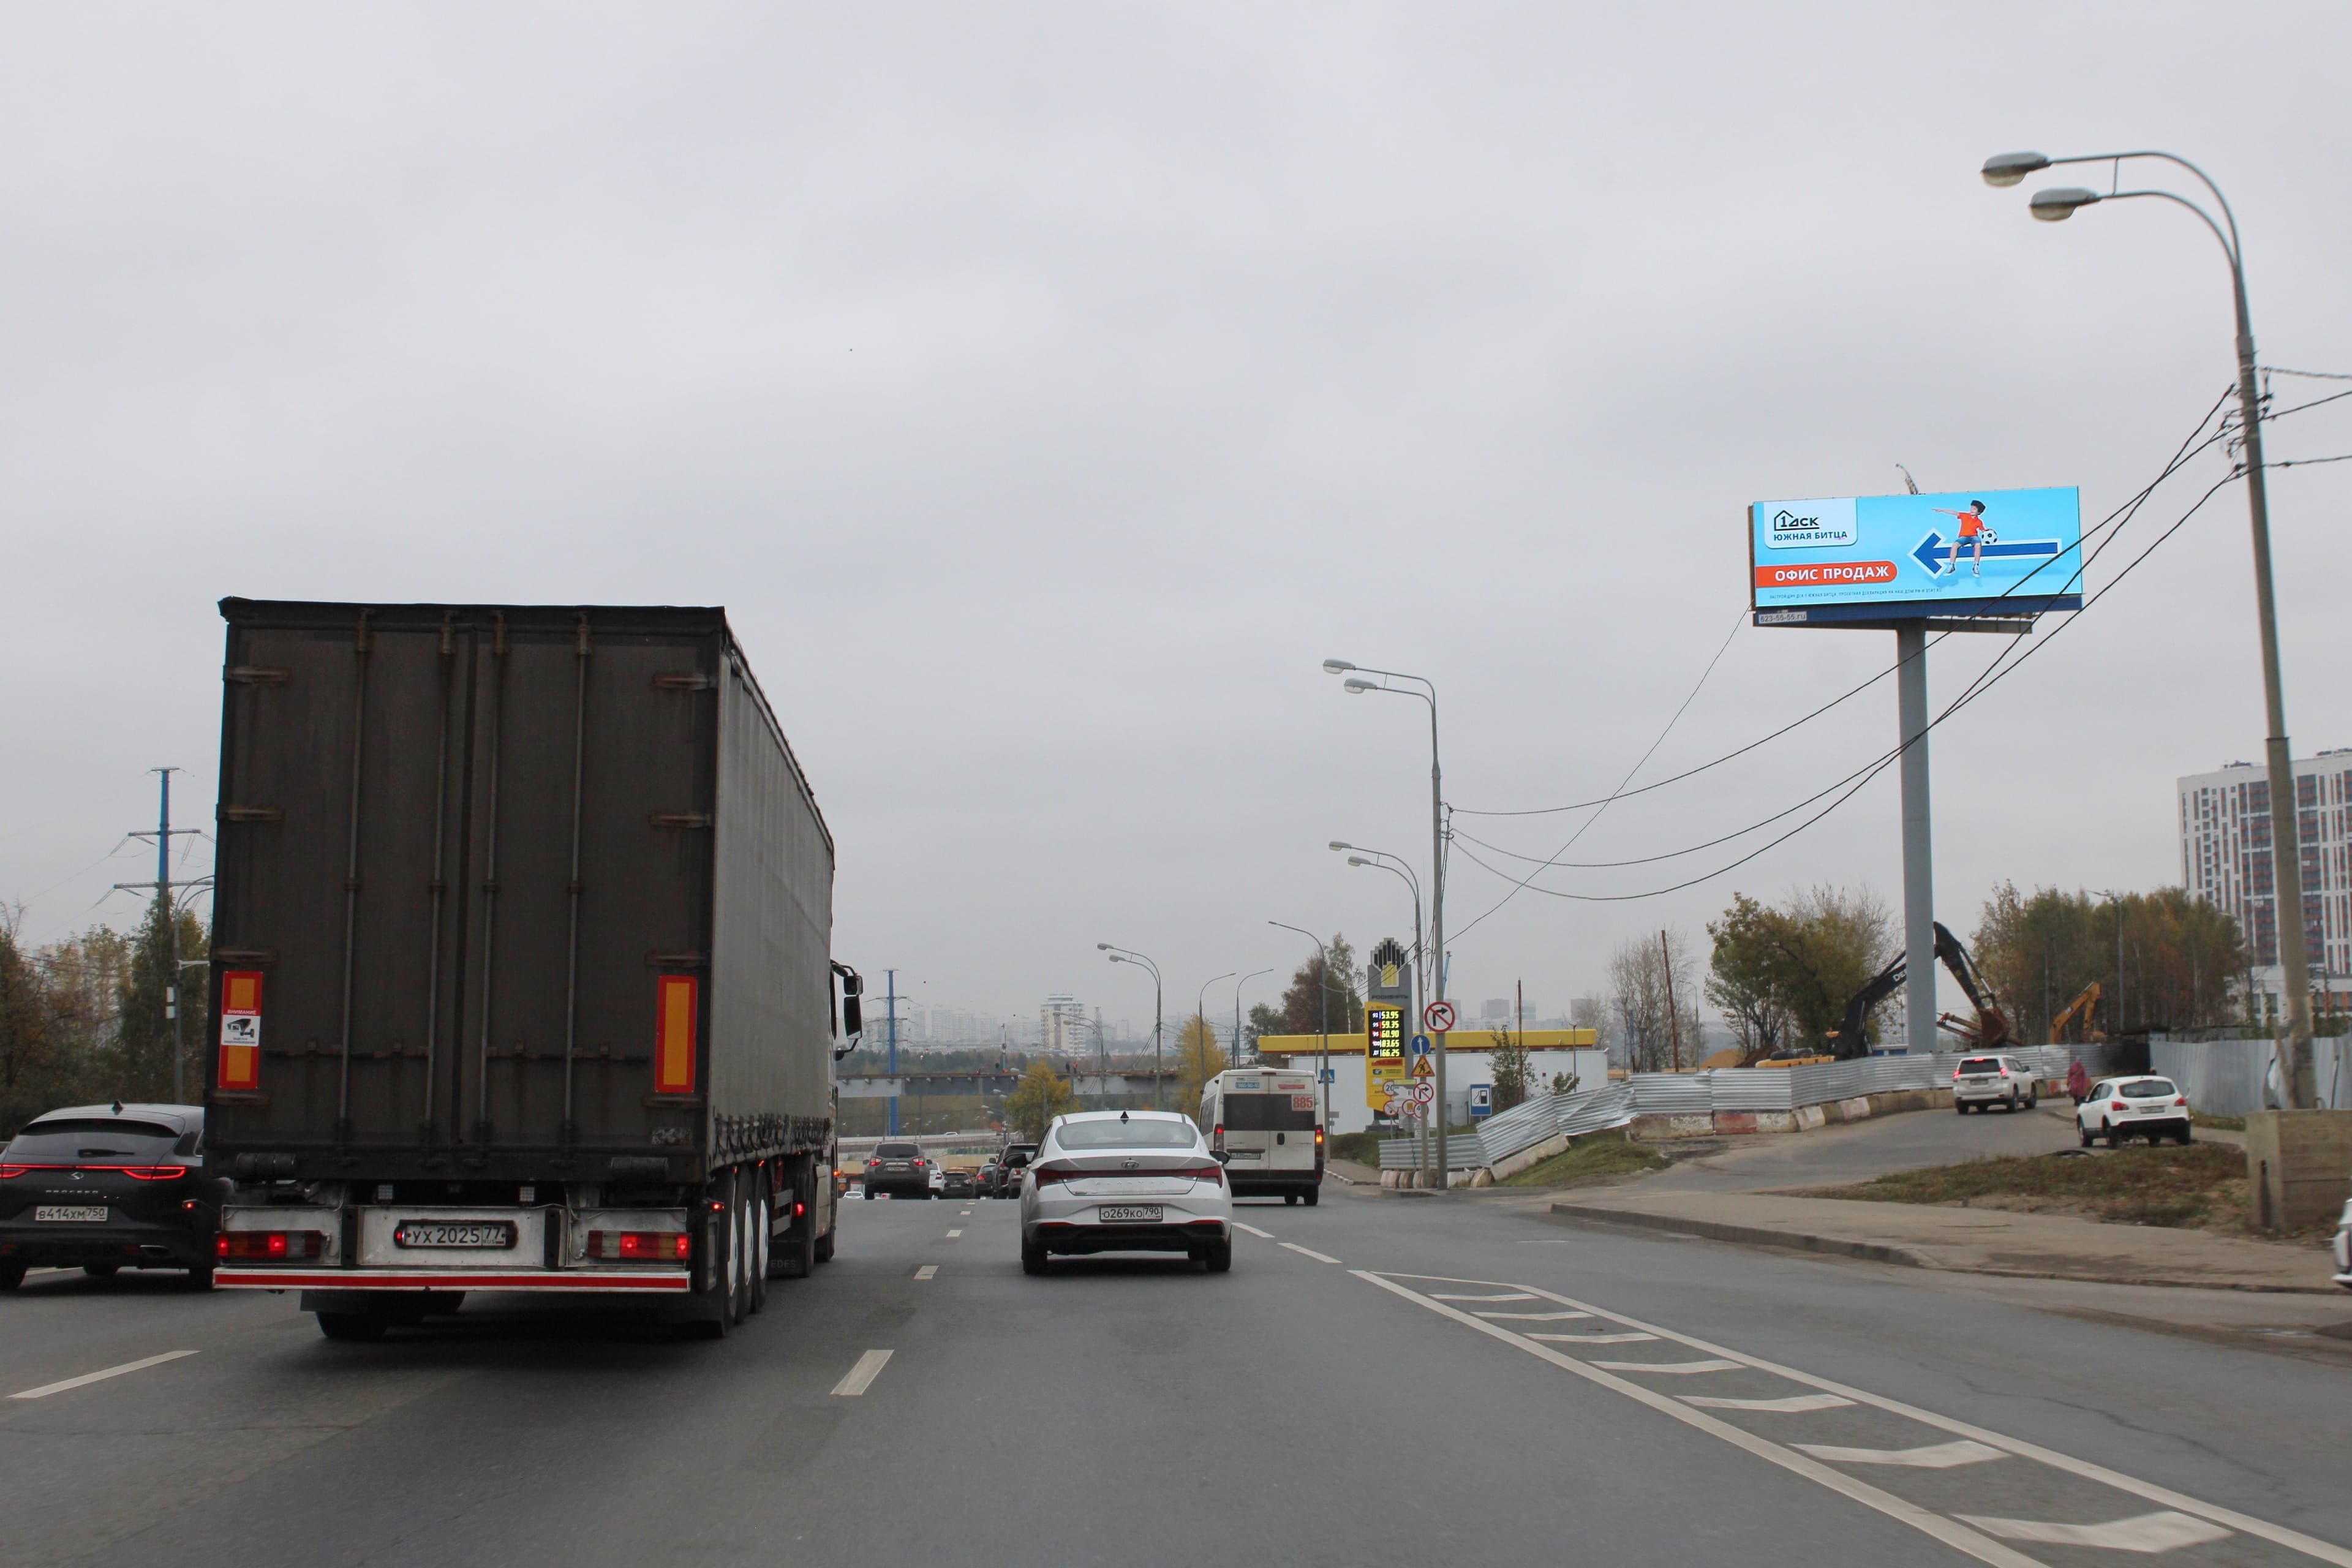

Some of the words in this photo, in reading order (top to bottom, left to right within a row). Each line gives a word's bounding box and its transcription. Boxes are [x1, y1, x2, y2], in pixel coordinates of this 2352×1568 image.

[1815, 531, 1847, 540] БИТЦА
[1775, 569, 1818, 581] ОФИС
[1823, 566, 1888, 581] ПРОДАЖ
[1381, 1030, 1400, 1038] 60.90
[1382, 1049, 1400, 1057] 66.25
[1293, 1097, 1313, 1109] 885
[86, 1207, 105, 1216] 750
[484, 1227, 501, 1239] 77
